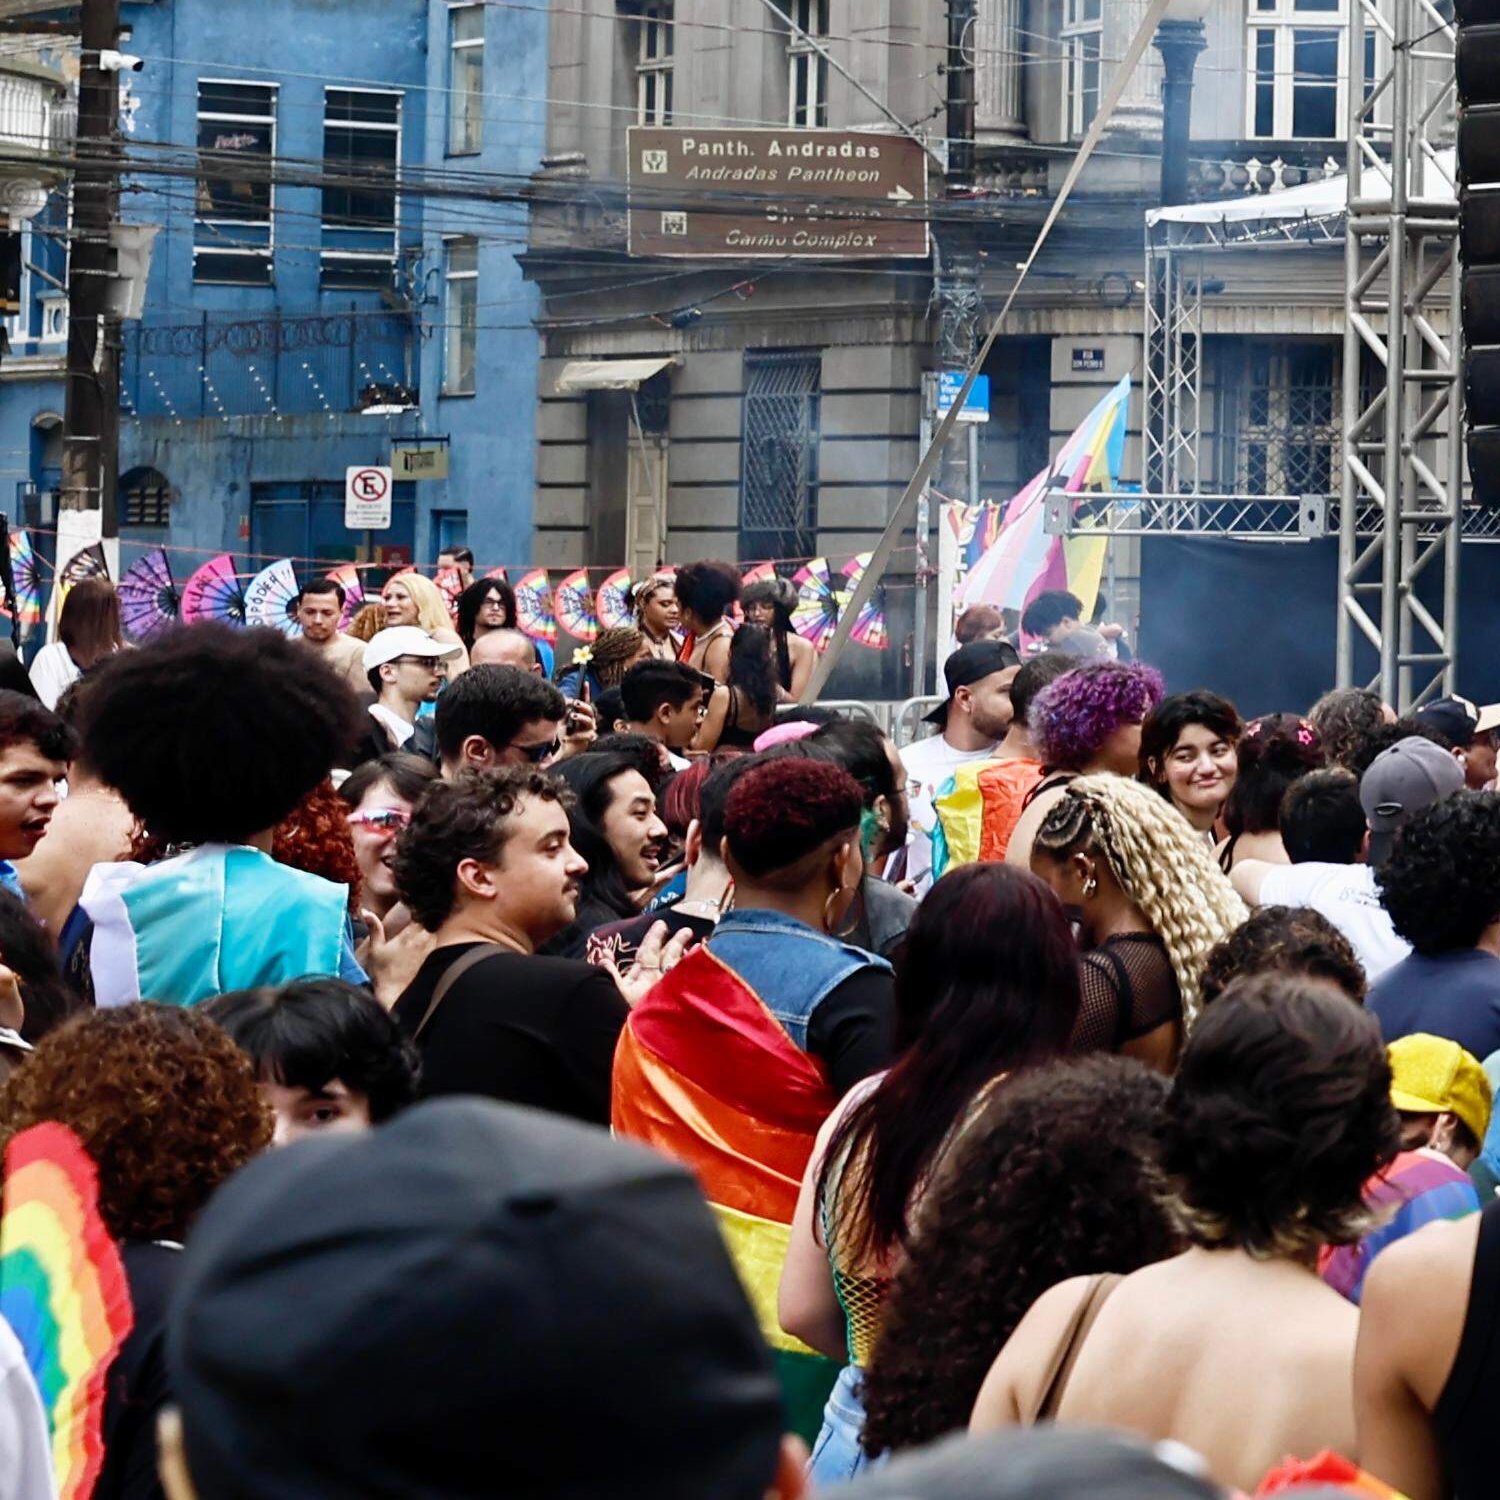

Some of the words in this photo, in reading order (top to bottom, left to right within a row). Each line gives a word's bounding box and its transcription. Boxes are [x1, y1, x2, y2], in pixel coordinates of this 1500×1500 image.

[682, 138, 756, 157] Panth.
[768, 139, 880, 158] Andradas
[685, 165, 778, 181] Andradas
[787, 166, 880, 182] Pantheon
[725, 229, 787, 246] Carmo
[792, 230, 877, 249] Complex
